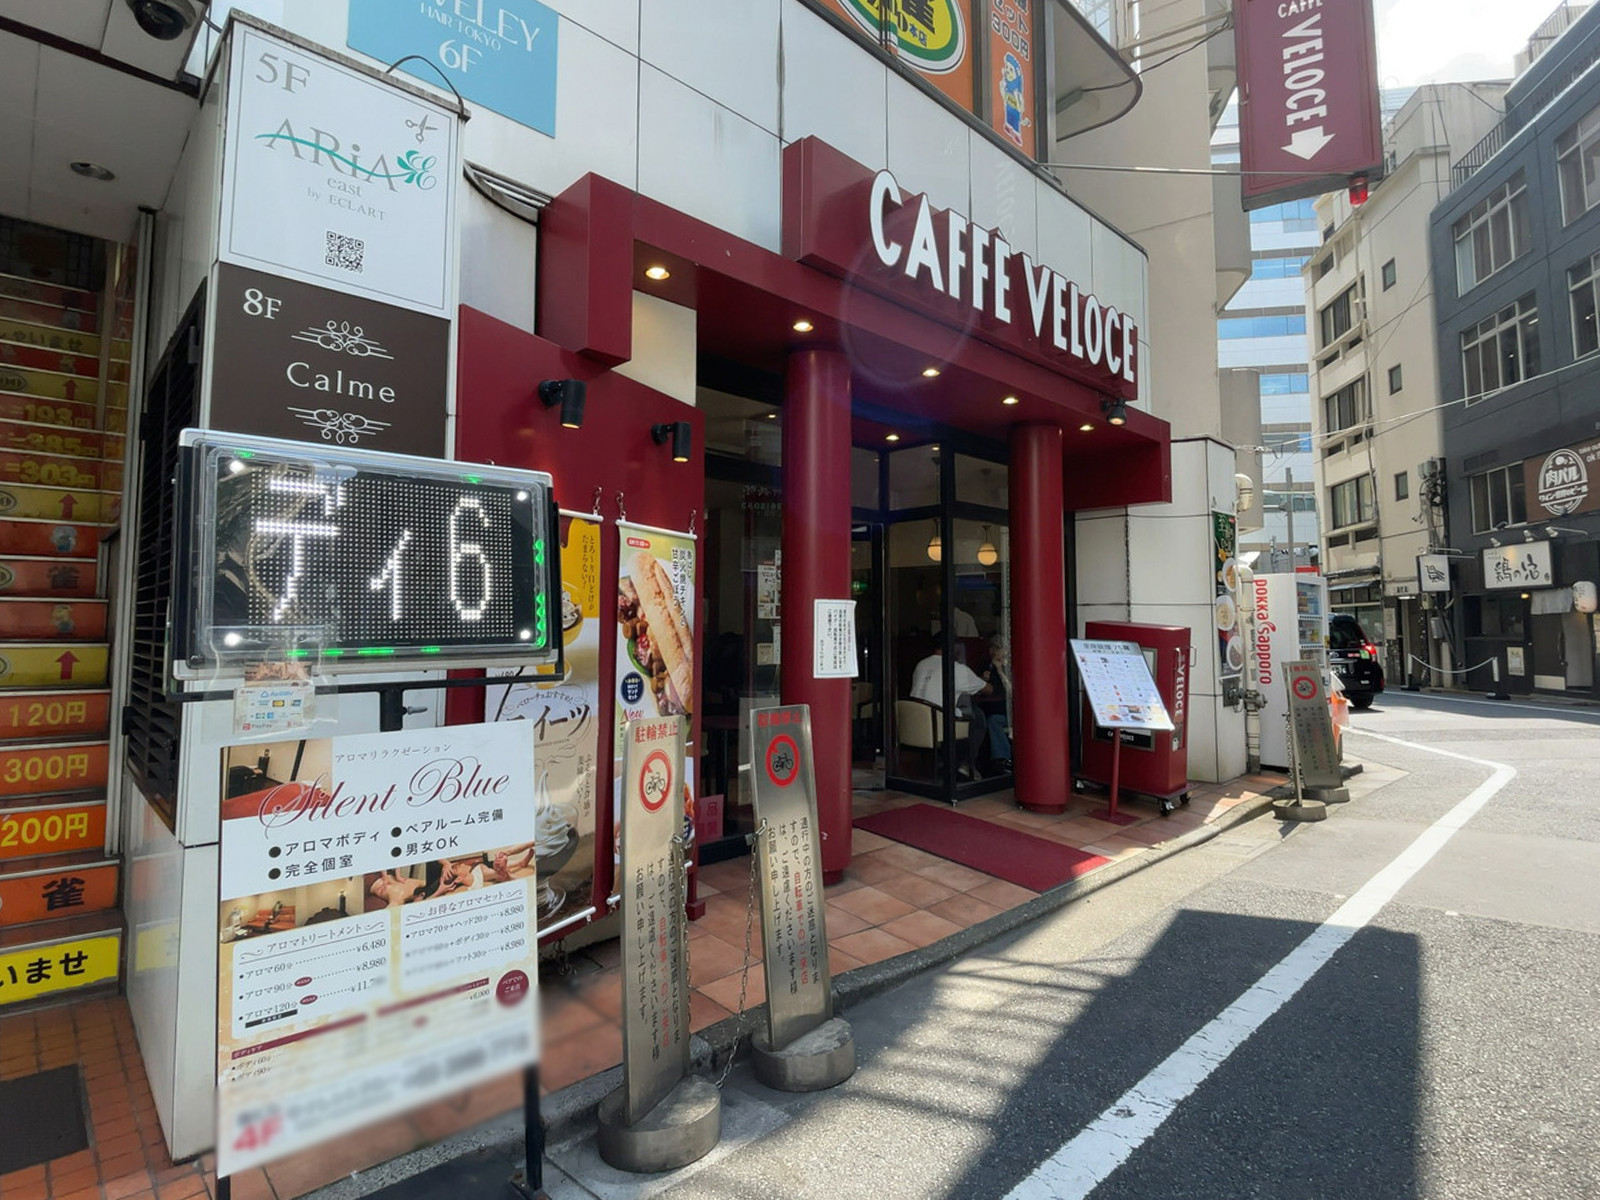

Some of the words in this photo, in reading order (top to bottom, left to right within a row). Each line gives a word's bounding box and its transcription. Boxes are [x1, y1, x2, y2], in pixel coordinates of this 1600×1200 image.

[420, 2, 454, 28] HAIR
[454, 19, 501, 51] TOKYO
[909, 23, 928, 47] 本店
[992, 11, 1029, 61] 300円
[439, 39, 483, 72] 6F
[1281, 13, 1327, 126] VELOCE
[255, 51, 311, 94] 5F
[327, 175, 363, 198] east
[307, 187, 321, 201] by
[329, 194, 387, 221] ECLART
[243, 287, 282, 320] 8F
[1022, 251, 1134, 384] VELOCE
[286, 362, 396, 403] Calme
[1545, 466, 1580, 488] 肉バル
[1253, 578, 1269, 620] pokka
[1257, 626, 1272, 685] sapporo
[1174, 664, 1185, 716] VELOCE
[10, 702, 86, 726] 120円
[635, 721, 678, 744] 駐輪禁止
[5, 755, 88, 783] 300円
[336, 744, 451, 763] アロマリラクゼーション
[258, 772, 397, 840] Silent
[406, 756, 510, 808] Blue
[406, 808, 504, 834] ペアルーム完備
[285, 831, 380, 856] アロマボディ
[406, 835, 458, 857] 男女OK
[285, 854, 354, 879] 完全個室
[43, 877, 85, 911] 雀
[428, 890, 505, 917] お得なアロマセット
[267, 922, 362, 953] アロマトリートメント
[356, 938, 386, 953] ¥6,480
